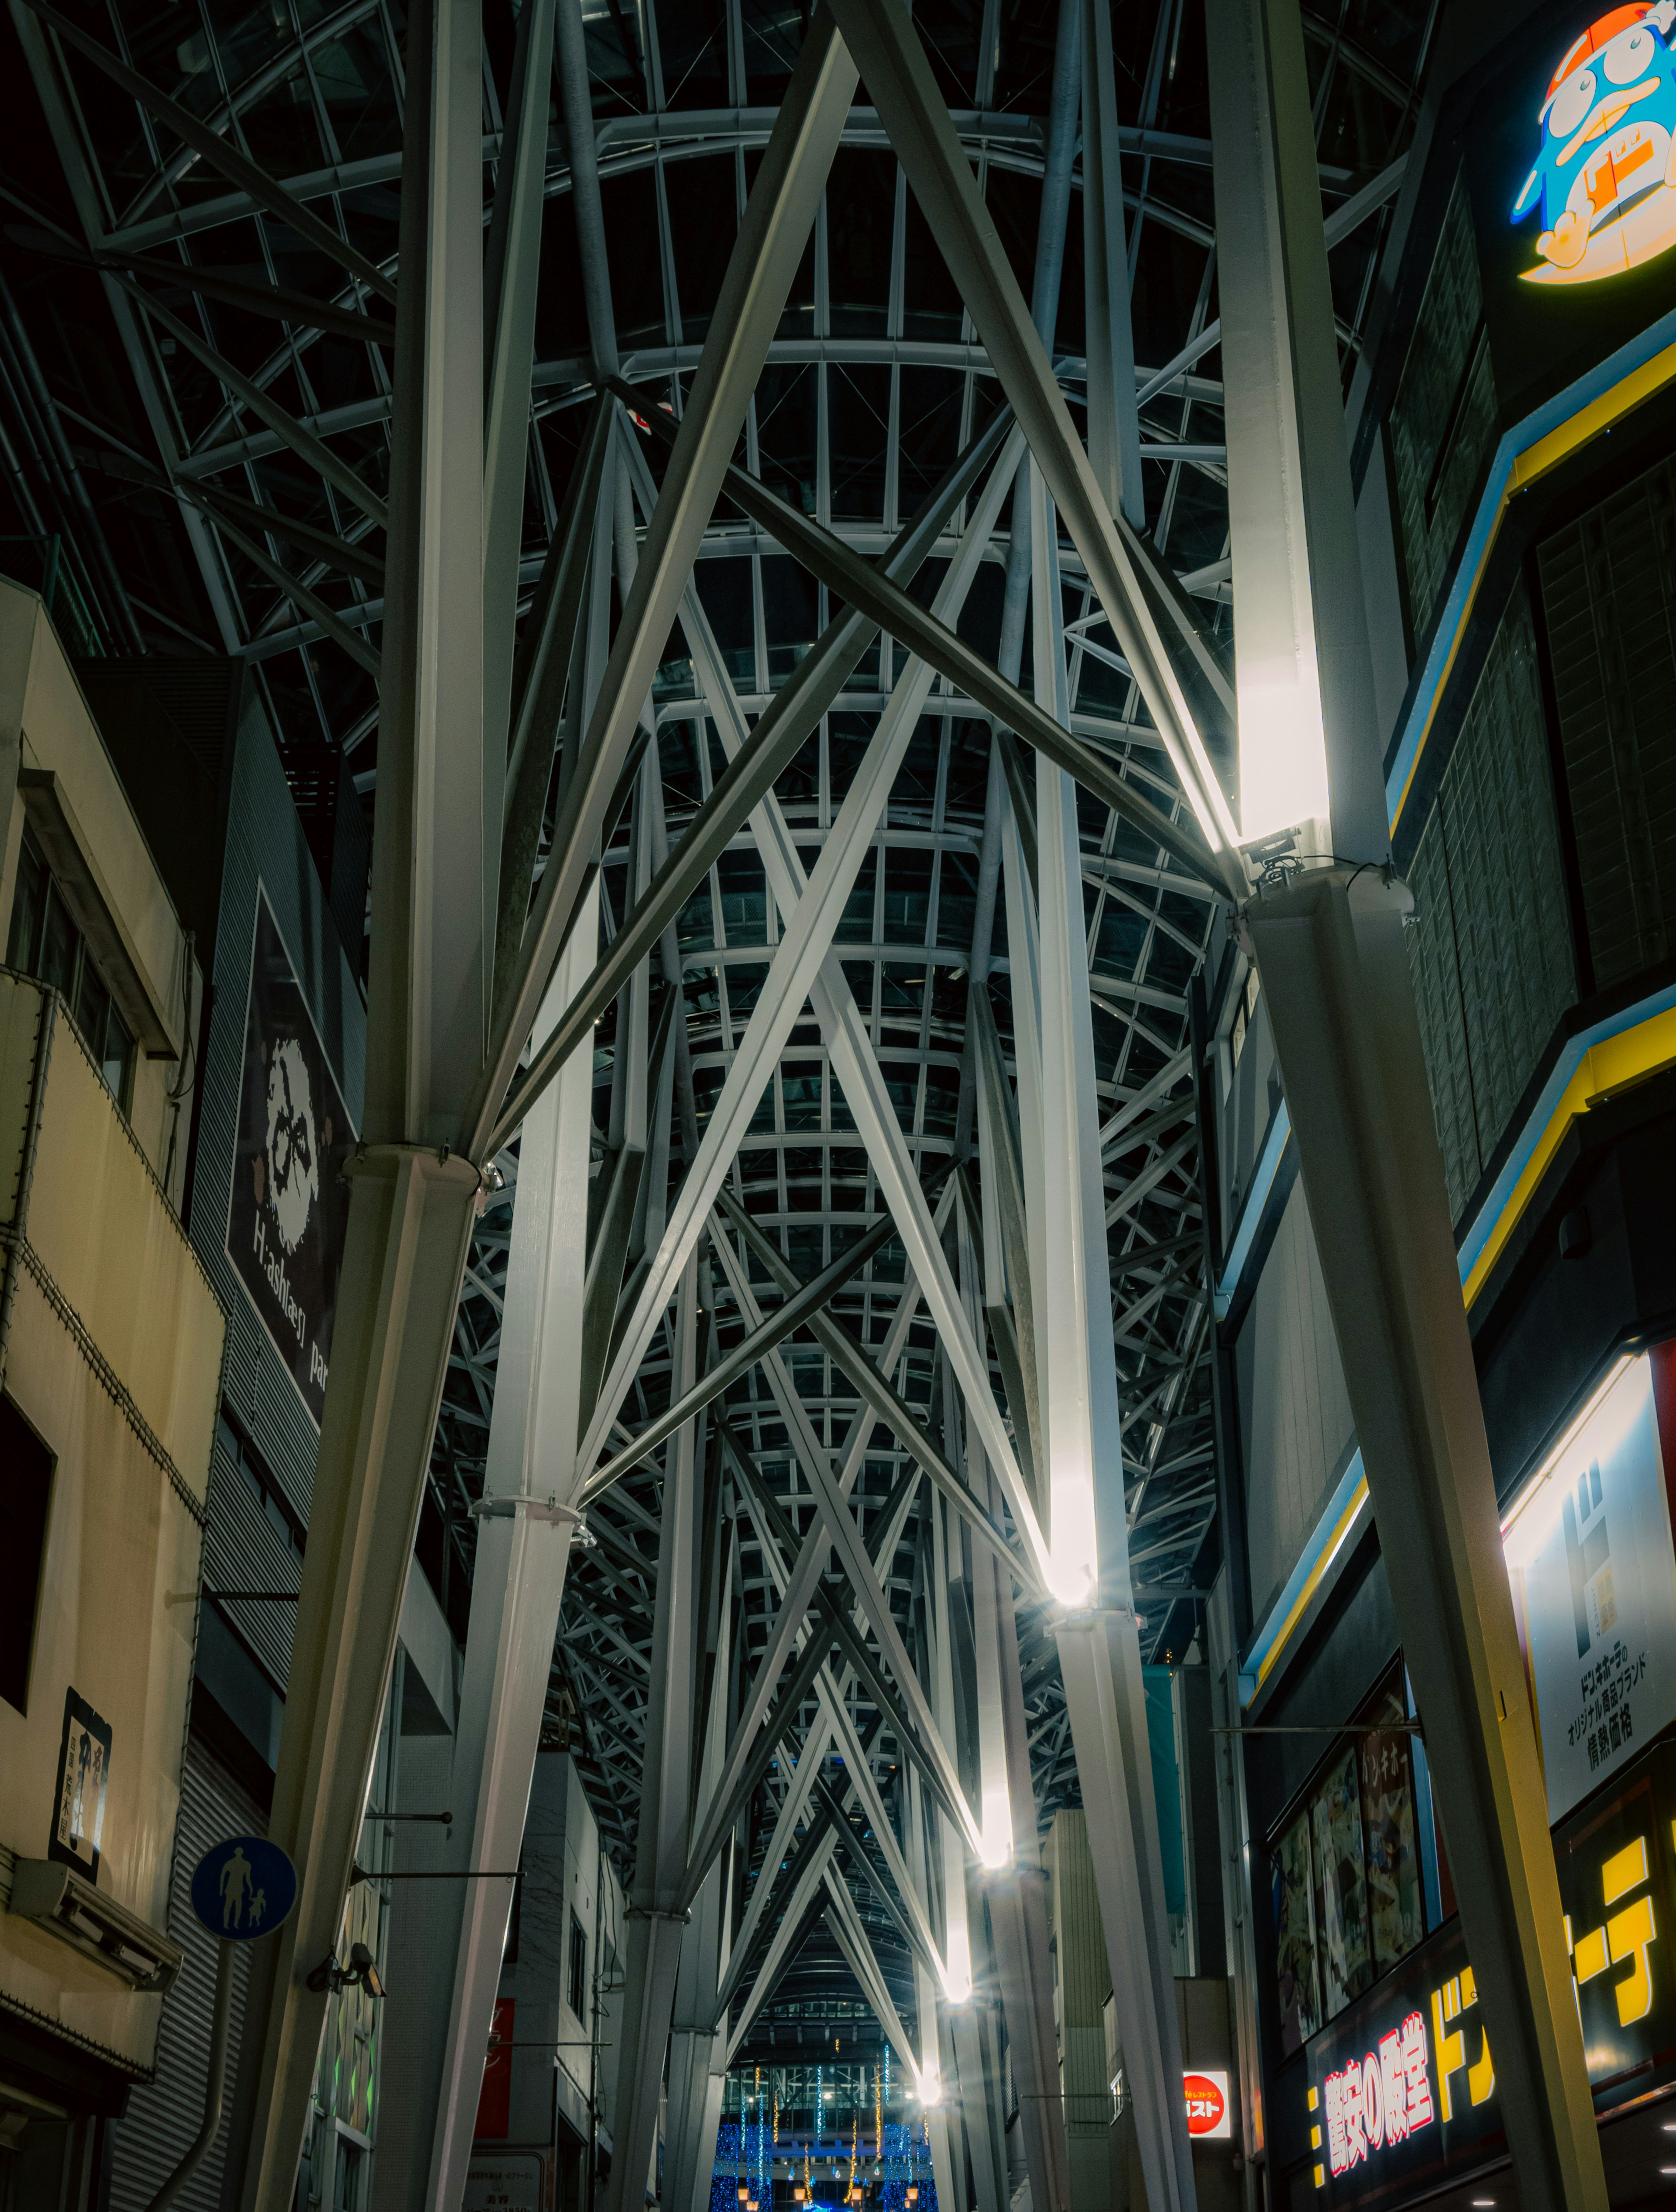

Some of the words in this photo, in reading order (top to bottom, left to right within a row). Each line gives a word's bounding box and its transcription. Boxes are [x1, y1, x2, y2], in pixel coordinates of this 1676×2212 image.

[1568, 1651, 1646, 1747] オリジナル商品ブランド
[1587, 1703, 1633, 1772] 情熱価格
[1325, 2011, 1434, 2178] 驚安の殿堂
